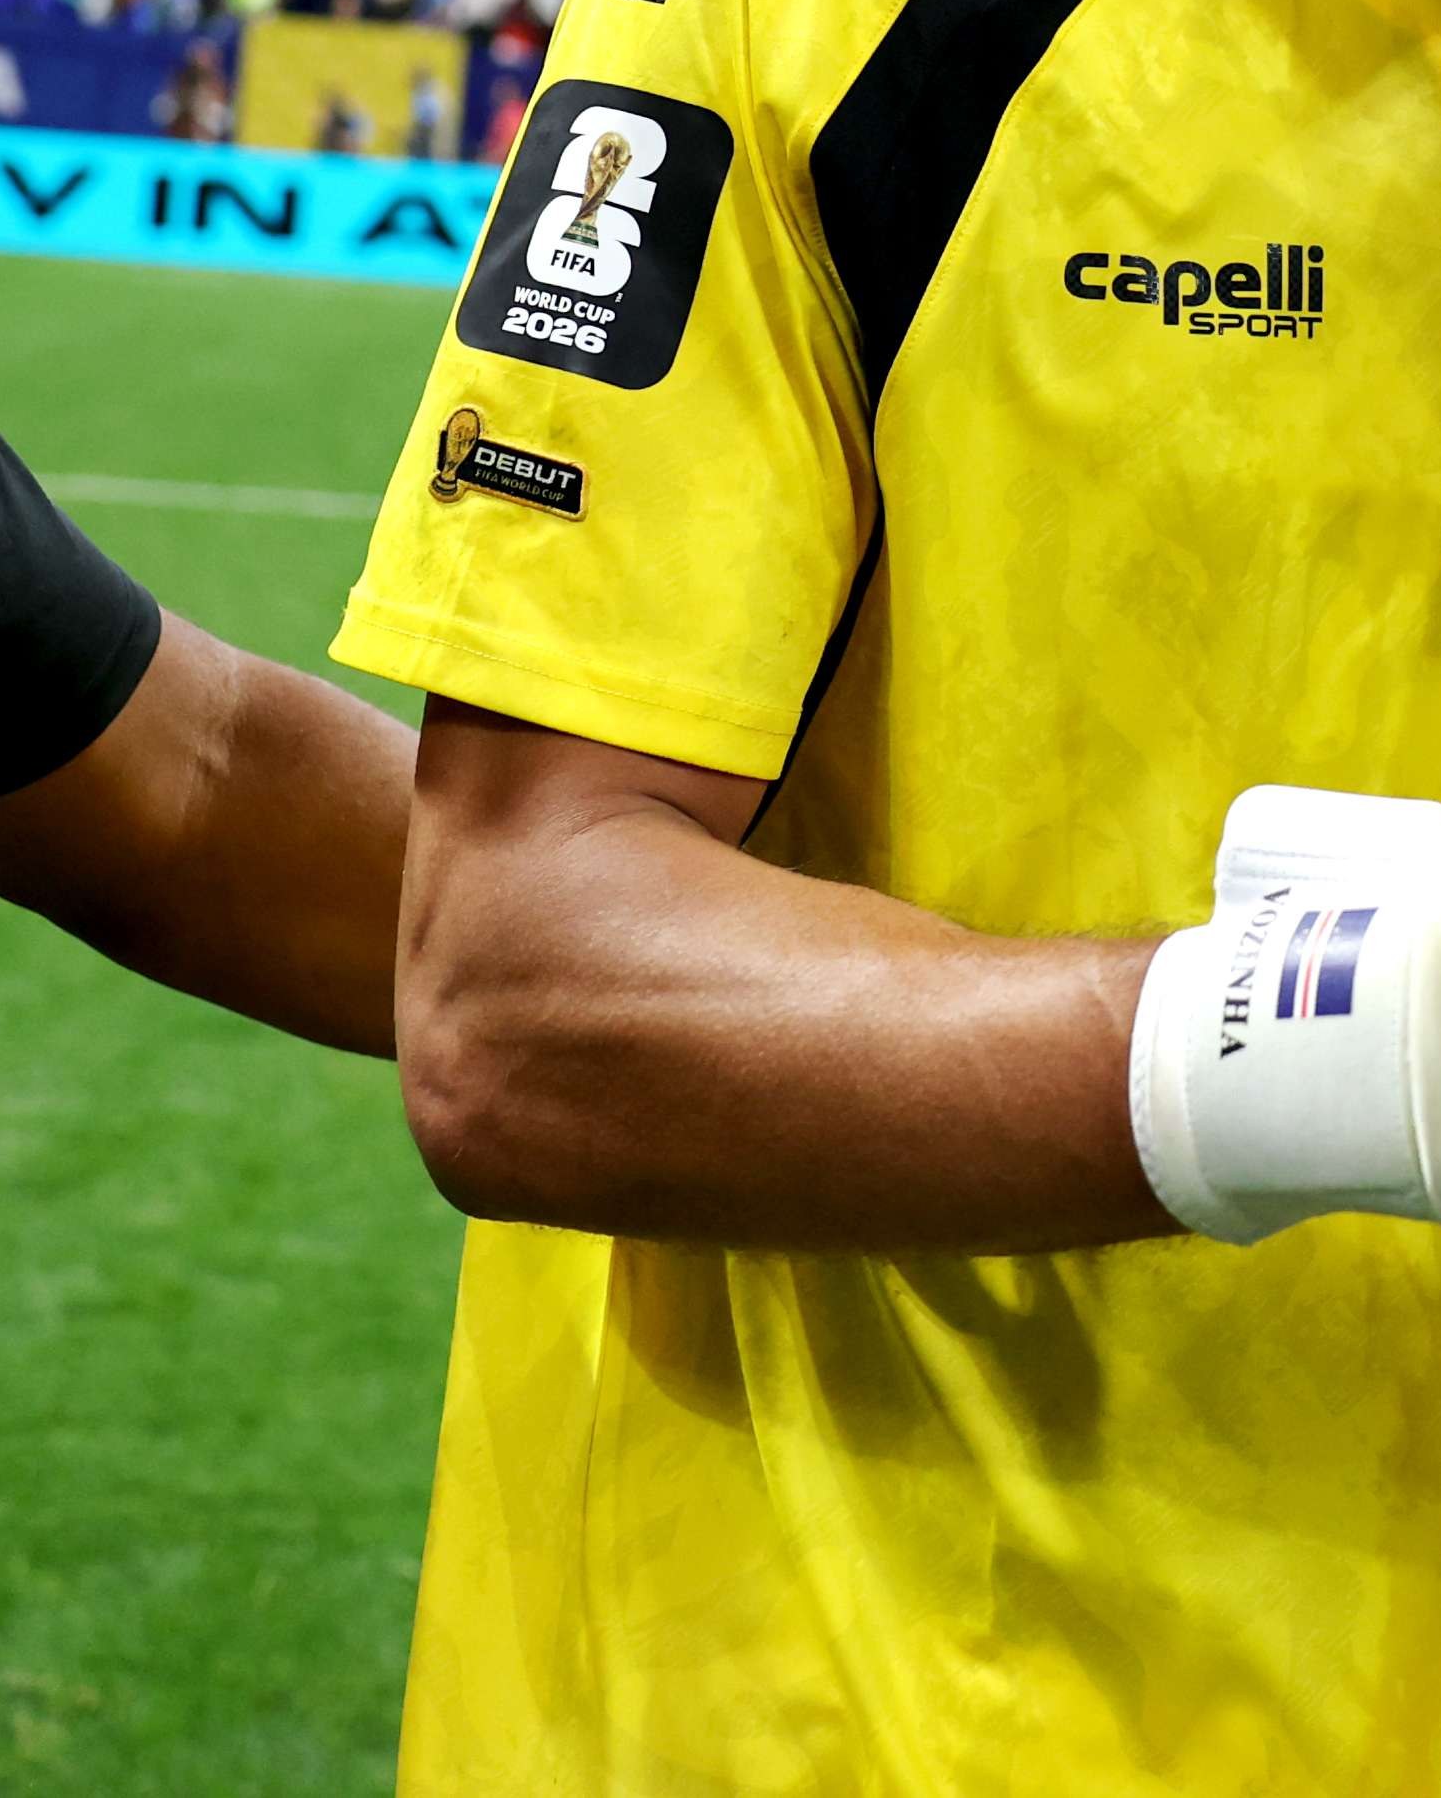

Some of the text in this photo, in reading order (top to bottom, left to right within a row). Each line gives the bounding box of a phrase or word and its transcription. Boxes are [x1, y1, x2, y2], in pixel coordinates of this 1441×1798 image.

[153, 177, 297, 237] IN
[550, 249, 596, 277] FIFA
[1063, 242, 1324, 325] capelli
[514, 285, 616, 325] WORLD CUP
[1188, 314, 1323, 339] SPORT
[501, 306, 607, 354] 2026
[474, 446, 577, 490] DEBUT
[474, 467, 566, 502] FIFA WORLD CUP
[1220, 887, 1291, 1059] VOZINHA
